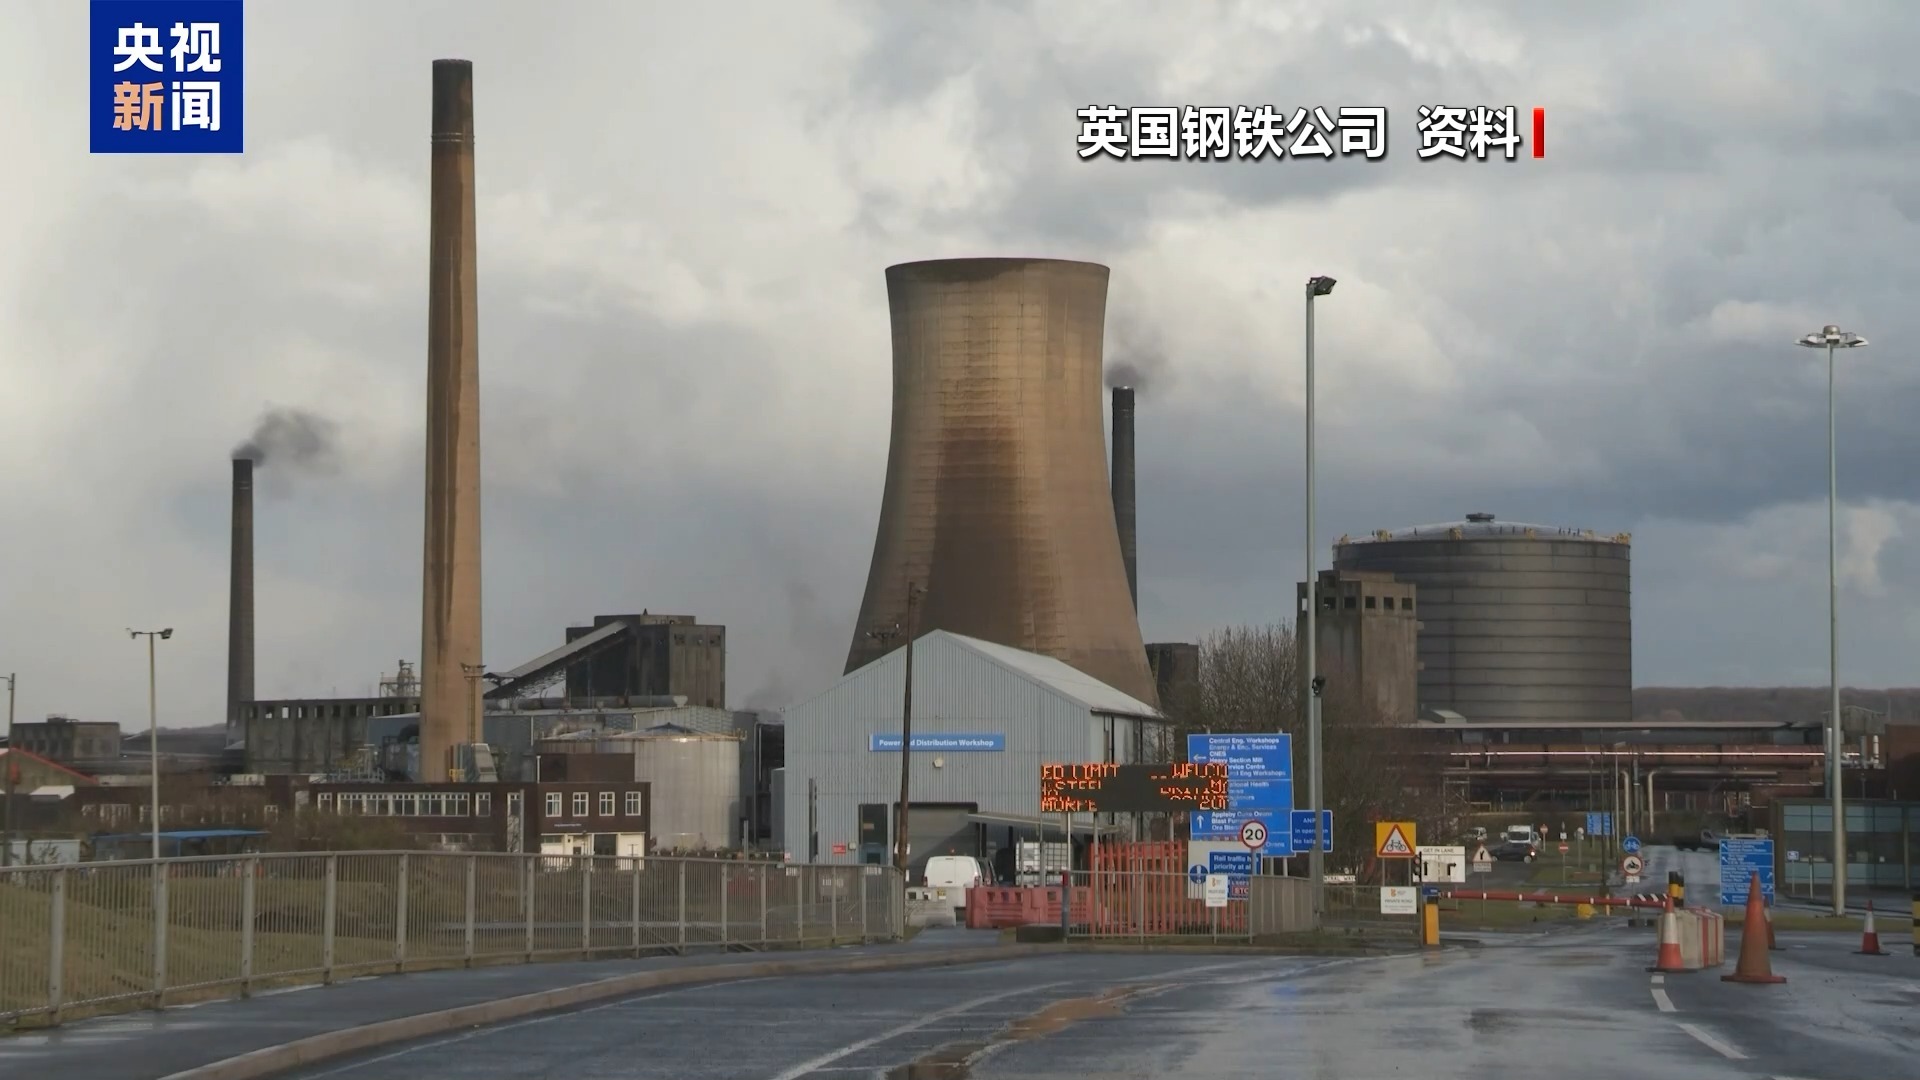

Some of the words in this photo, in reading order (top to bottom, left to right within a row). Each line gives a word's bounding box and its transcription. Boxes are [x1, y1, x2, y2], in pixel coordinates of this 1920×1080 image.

[959, 739, 994, 748] Workshop
[1246, 737, 1280, 746] Workshops
[1211, 811, 1236, 820] Appleby
[1245, 829, 1264, 840] 20
[1214, 854, 1227, 862] Rail
[1227, 854, 1246, 862] traffic
[1214, 862, 1236, 871] priority
